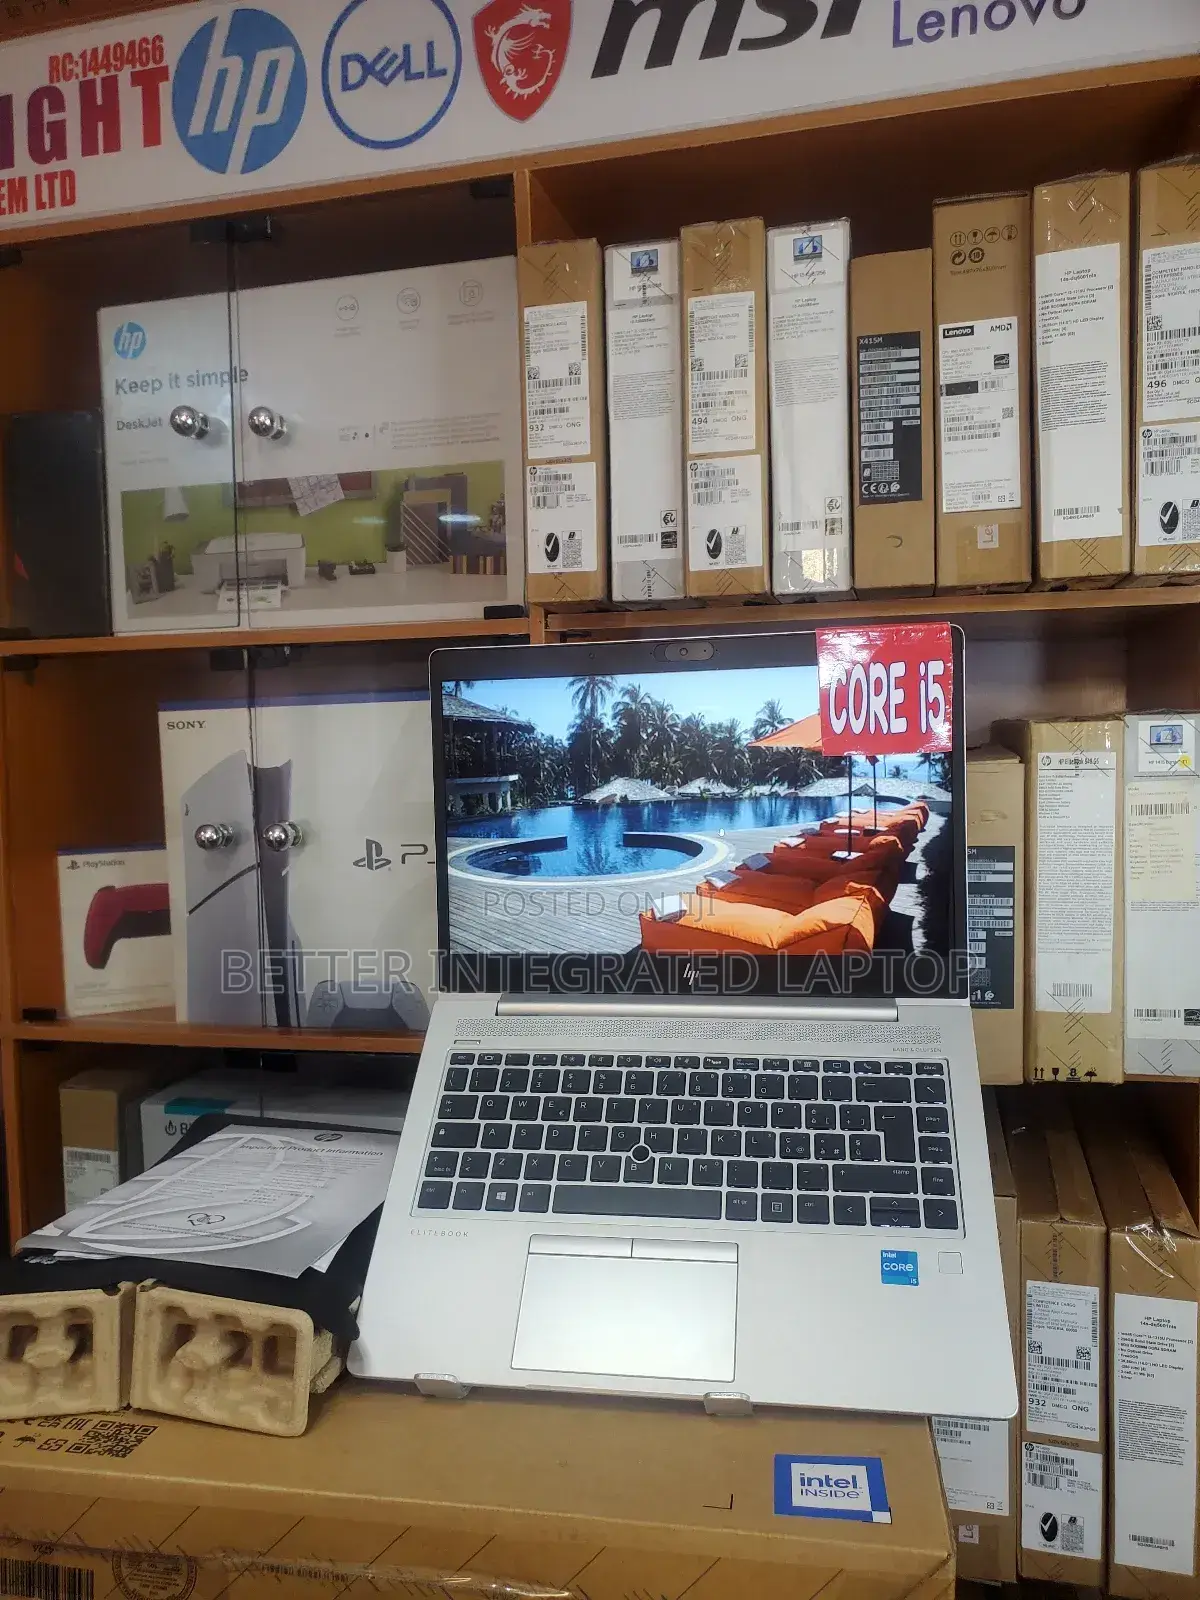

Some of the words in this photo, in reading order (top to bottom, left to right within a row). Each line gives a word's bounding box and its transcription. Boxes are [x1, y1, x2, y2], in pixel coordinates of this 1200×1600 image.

[892, 0, 1085, 48] Lenovo
[49, 34, 165, 84] RC:1449466
[341, 40, 447, 92] DELL
[180, 8, 300, 175] hp
[35, 169, 76, 211] LTD
[944, 326, 972, 337] Lenovo
[990, 324, 1005, 332] AMD
[113, 321, 147, 359] hp
[115, 378, 162, 395] Keep
[168, 372, 180, 389] it
[186, 366, 249, 388] simple
[1147, 380, 1167, 389] 496
[116, 417, 162, 431] DeskJet
[692, 417, 708, 425] 494
[529, 424, 545, 432] 932
[828, 660, 908, 736] CORE
[919, 660, 945, 733] i5
[167, 720, 206, 730] SONY
[82, 858, 126, 869] PlayStation
[618, 1131, 625, 1139] G
[684, 1133, 689, 1141] J
[752, 1136, 757, 1144] L
[240, 1144, 287, 1152] Important
[286, 1145, 323, 1155] Product
[598, 1160, 605, 1168] V
[631, 1163, 637, 1171] B
[665, 1163, 672, 1171] N
[410, 1229, 469, 1238] ELITEBOOK
[1028, 1398, 1047, 1407] 932
[1072, 1405, 1089, 1413] ONG
[800, 1472, 859, 1489] intel
